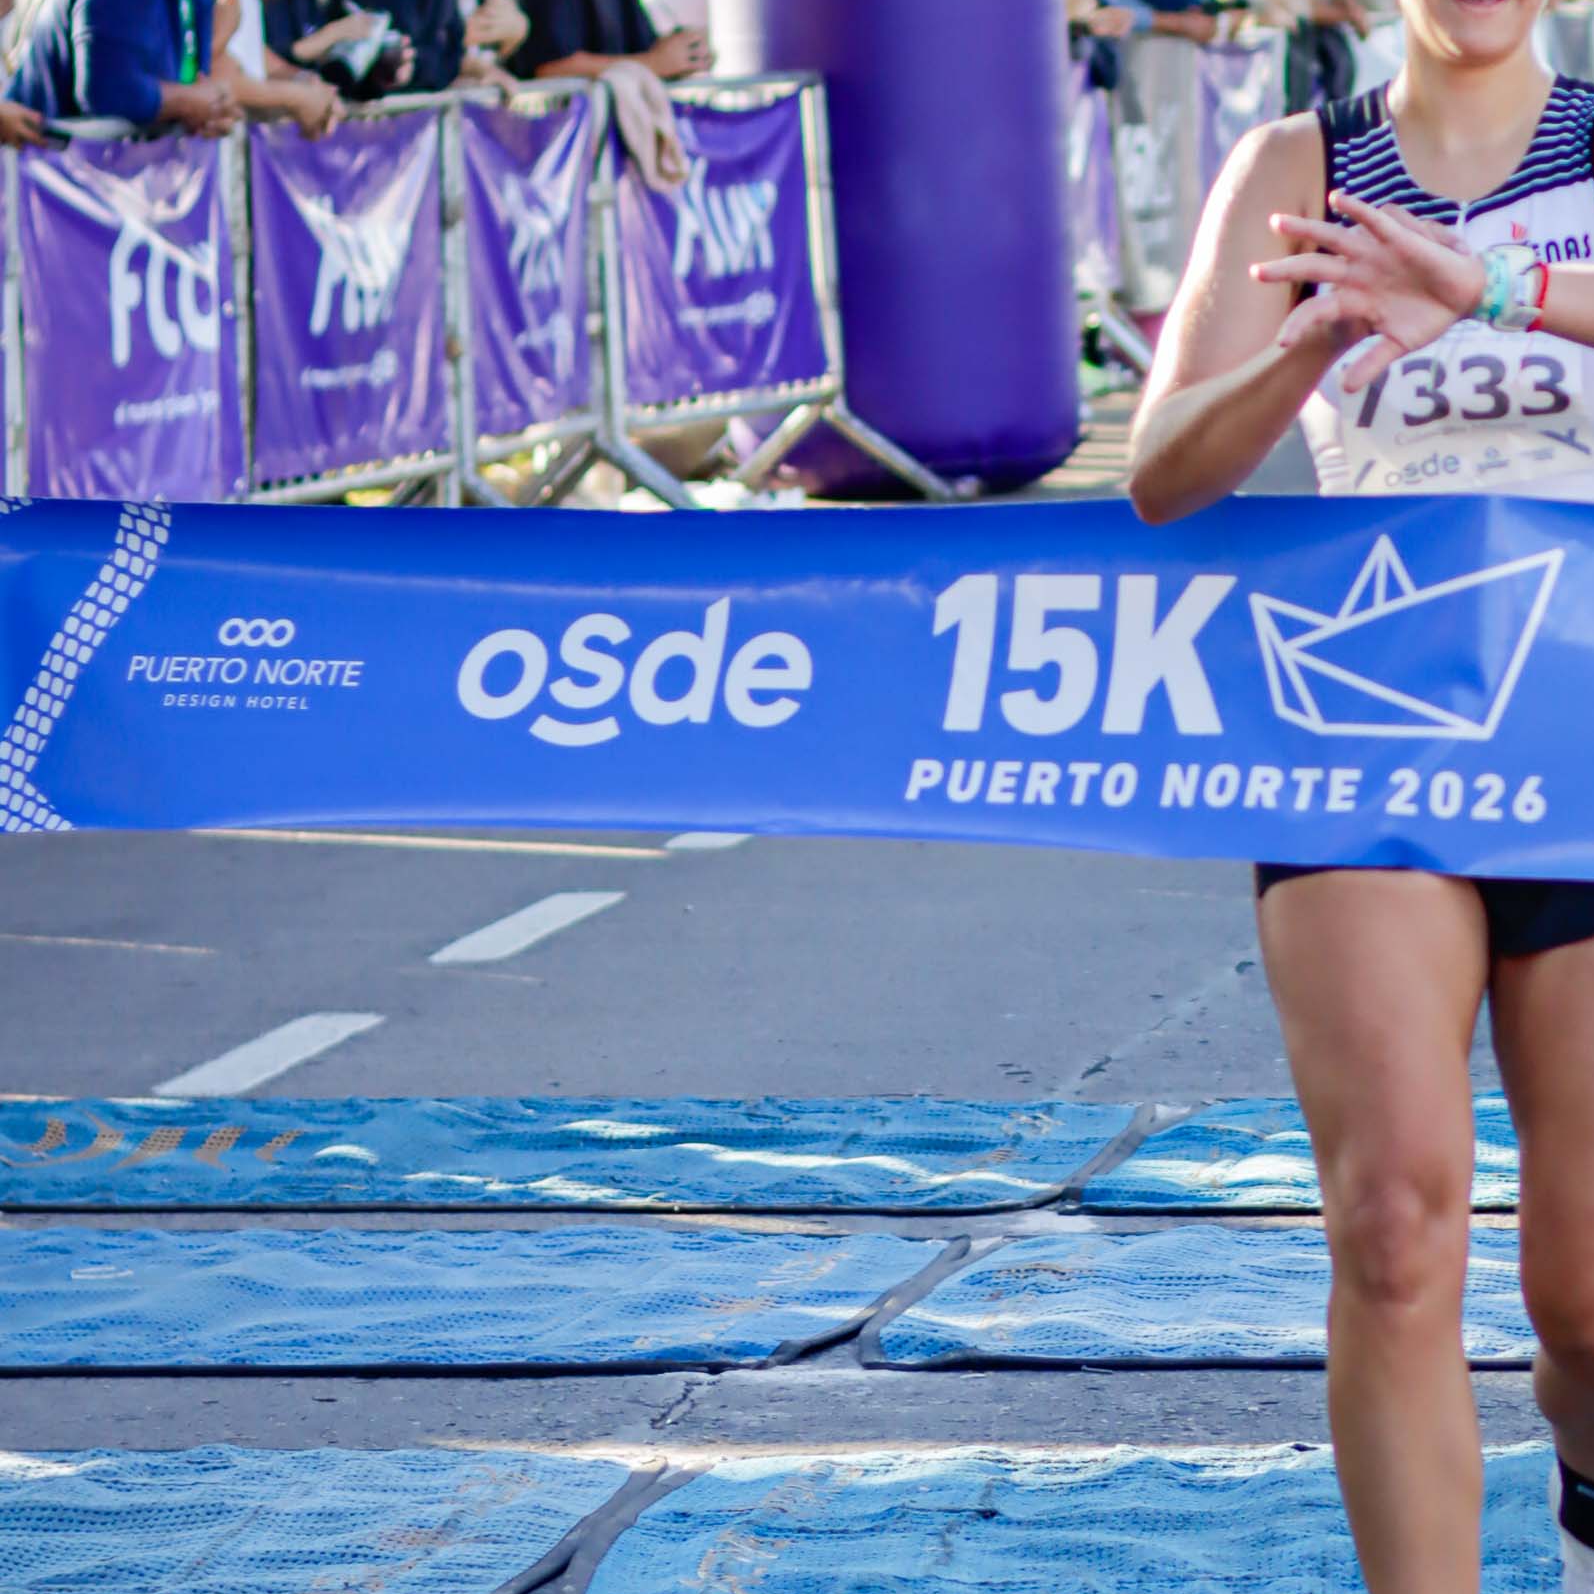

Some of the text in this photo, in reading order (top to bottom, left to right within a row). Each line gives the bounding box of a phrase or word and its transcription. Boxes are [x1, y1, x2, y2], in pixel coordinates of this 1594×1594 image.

[127, 654, 365, 687] PUERTO NORTE
[457, 596, 814, 728] osde
[932, 573, 1238, 736] 15K
[162, 693, 310, 710] DESIGN HOTEL
[905, 758, 1548, 824] PUERTO NORTE 2026
